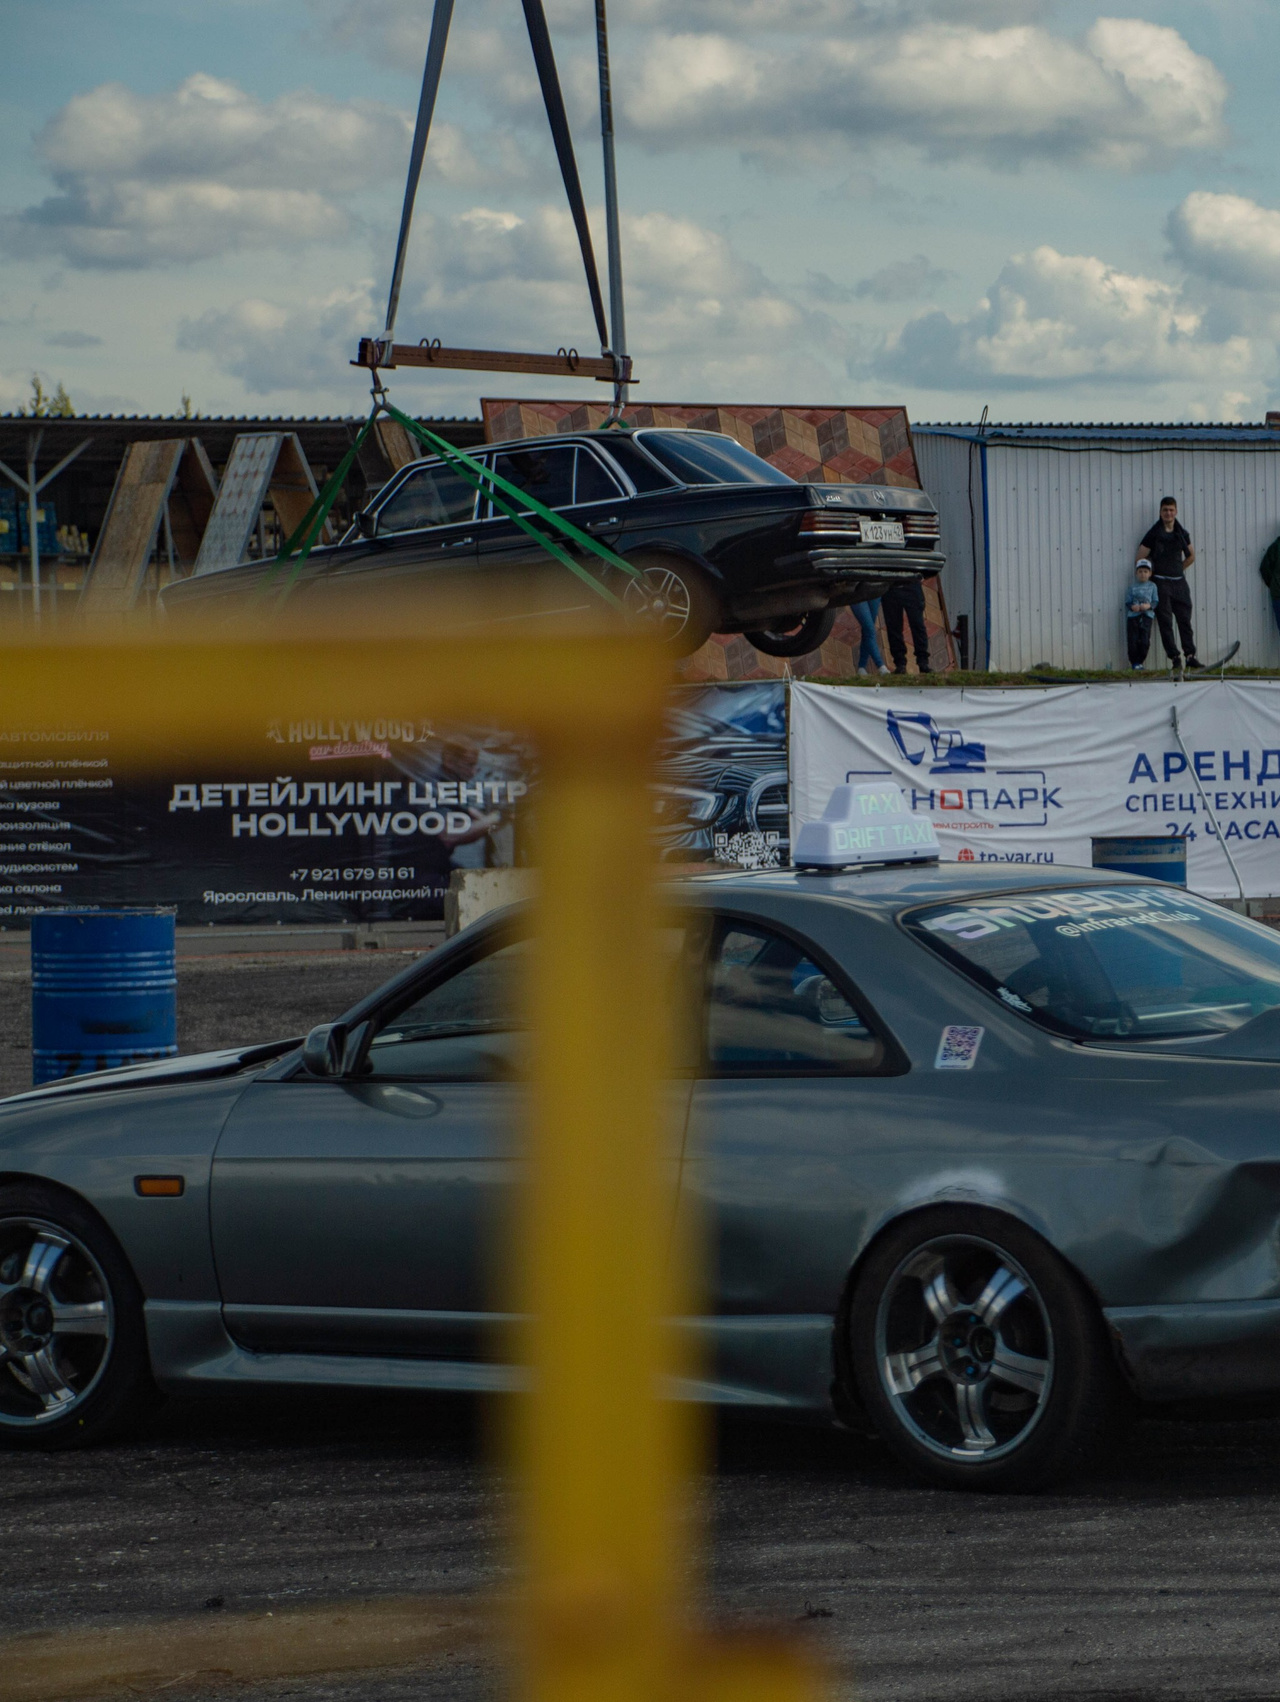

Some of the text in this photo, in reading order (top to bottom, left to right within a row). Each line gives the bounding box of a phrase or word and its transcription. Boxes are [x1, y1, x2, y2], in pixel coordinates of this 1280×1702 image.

[168, 777, 528, 812] ДЕТЕЙЛИНГ ЦЕНТР
[900, 787, 1064, 811] НОПАРК
[231, 811, 473, 838] HOLLYWOOD
[834, 822, 934, 850] DRIFT TAXI
[289, 867, 416, 882] +7 921 679 51 61
[203, 889, 299, 905] Ярославль,
[301, 885, 431, 903] Ленинградский
